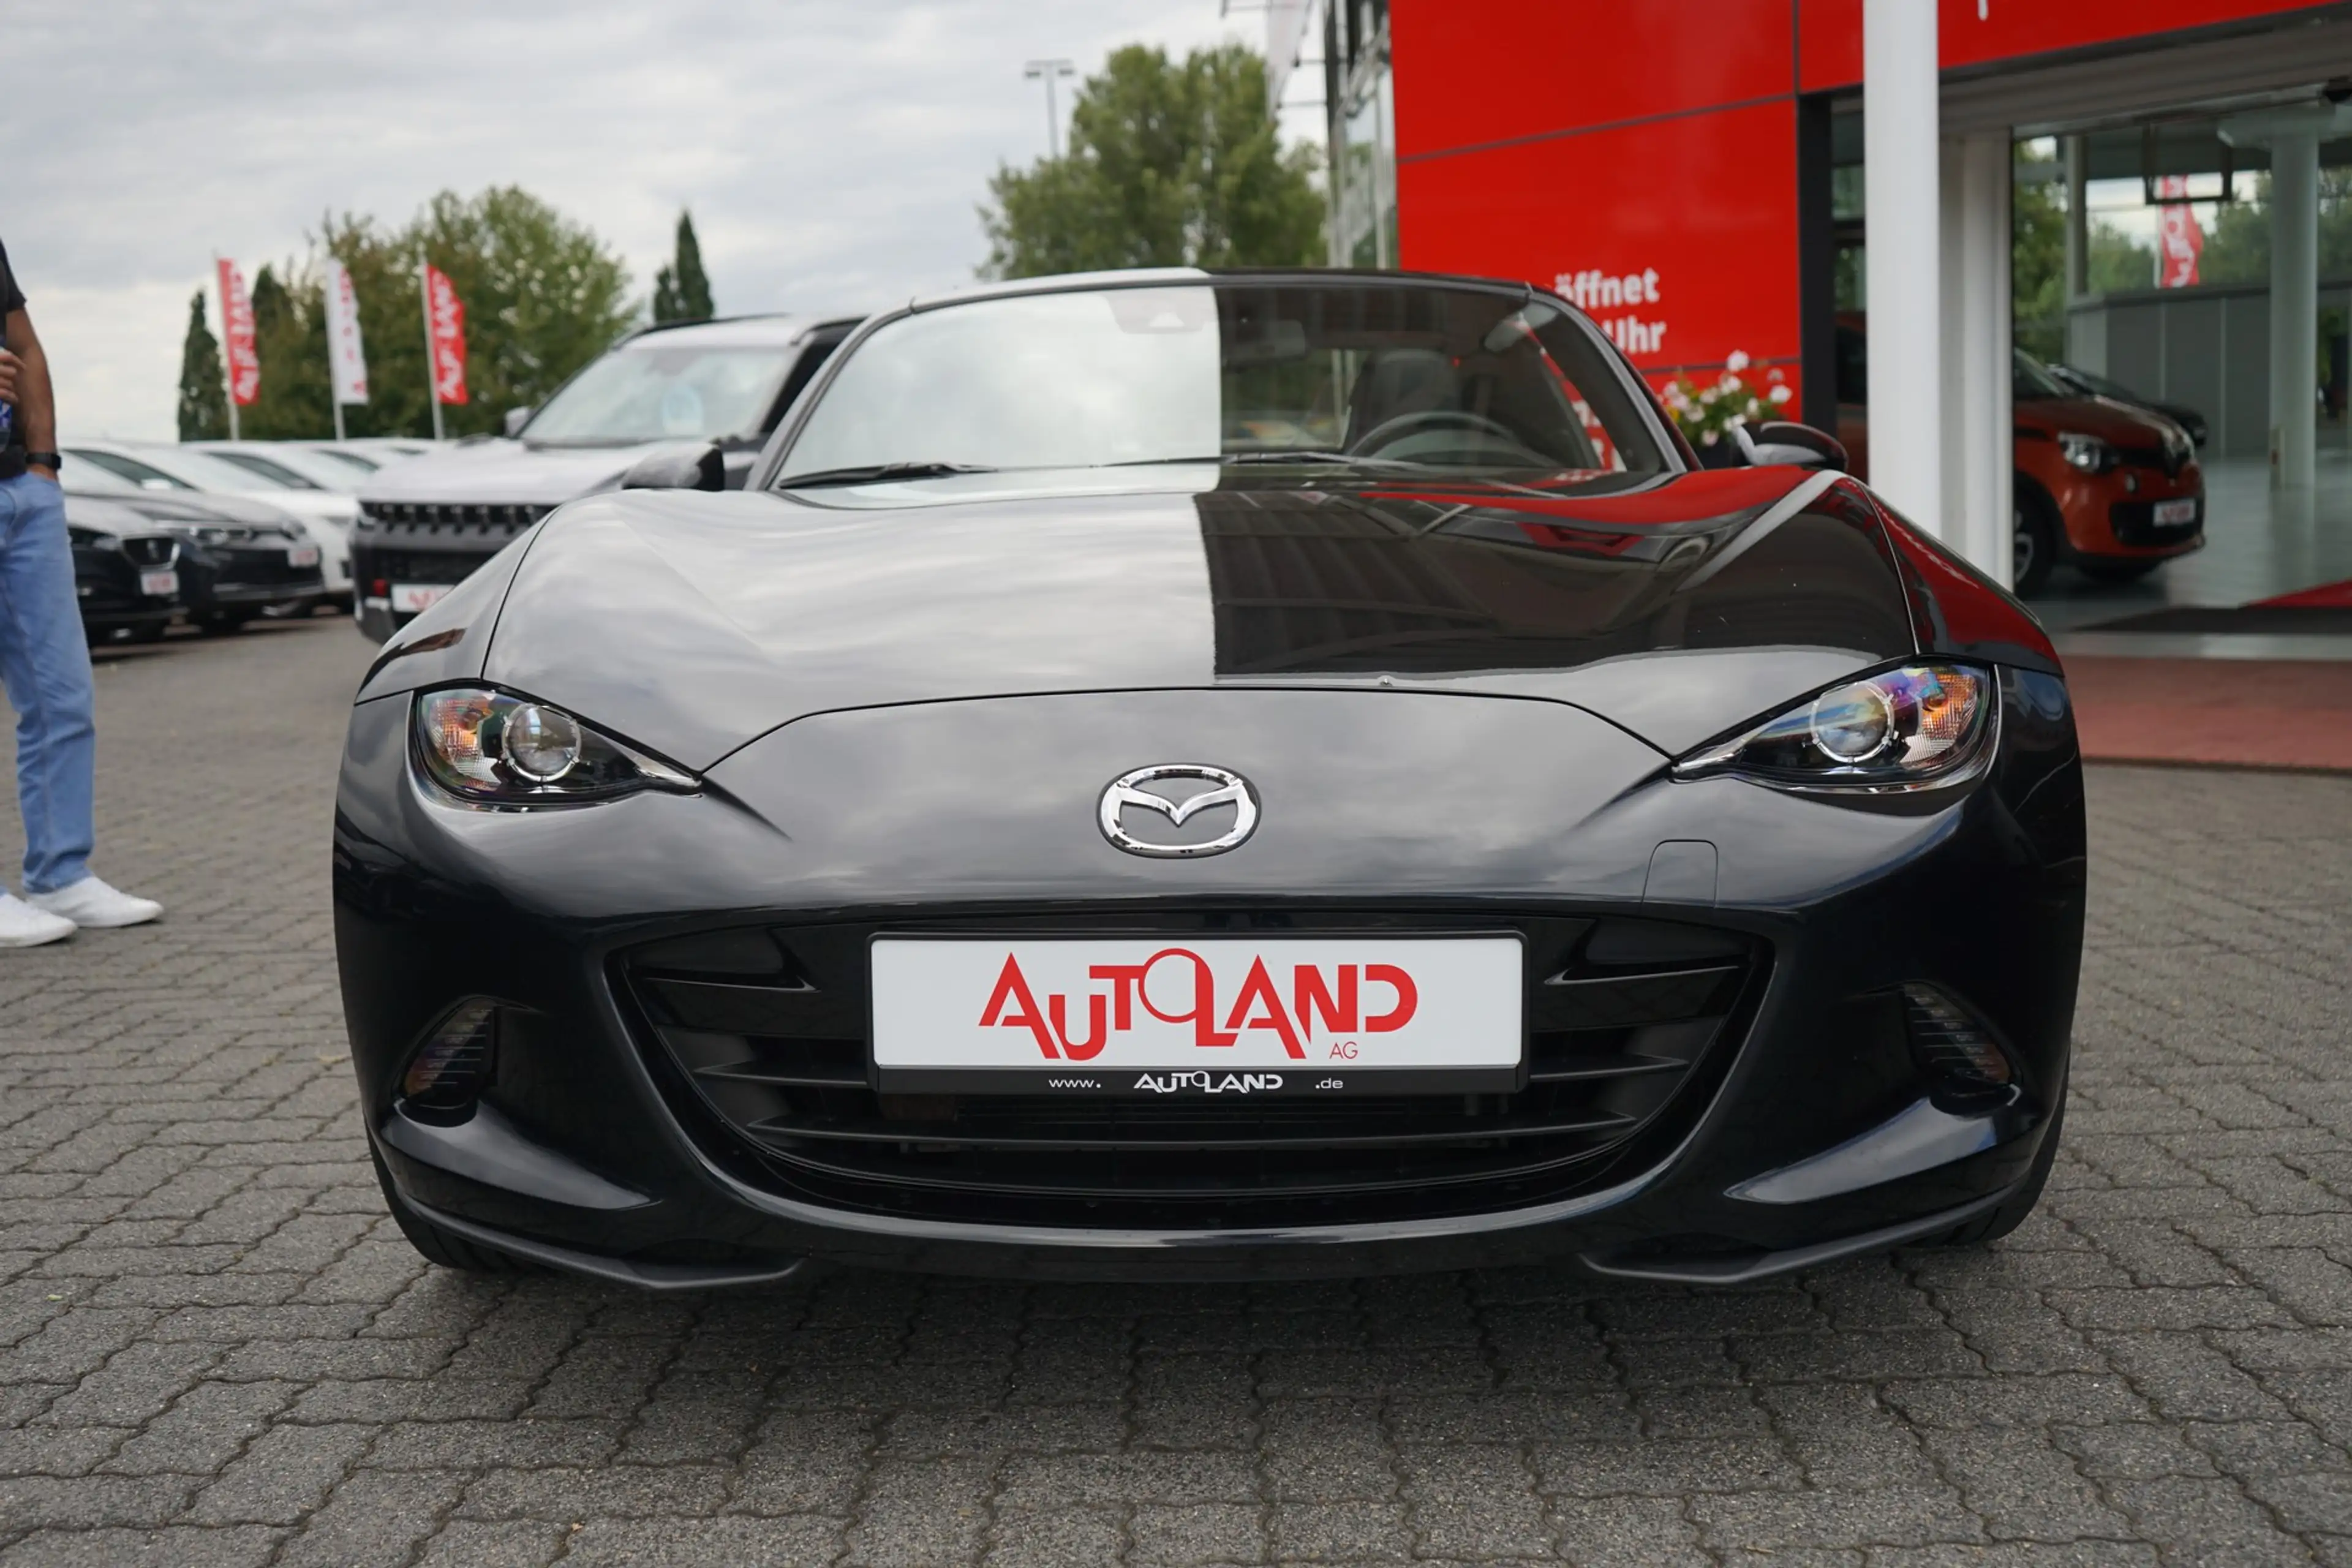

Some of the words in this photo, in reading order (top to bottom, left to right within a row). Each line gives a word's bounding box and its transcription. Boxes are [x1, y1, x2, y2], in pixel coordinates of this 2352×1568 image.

[979, 948, 1418, 1061] AUTOLAND
[1329, 1041, 1358, 1060] AG
[1049, 1078, 1101, 1089] www.
[1133, 1070, 1284, 1093] AUTOLAND
[1315, 1076, 1343, 1089] .de
